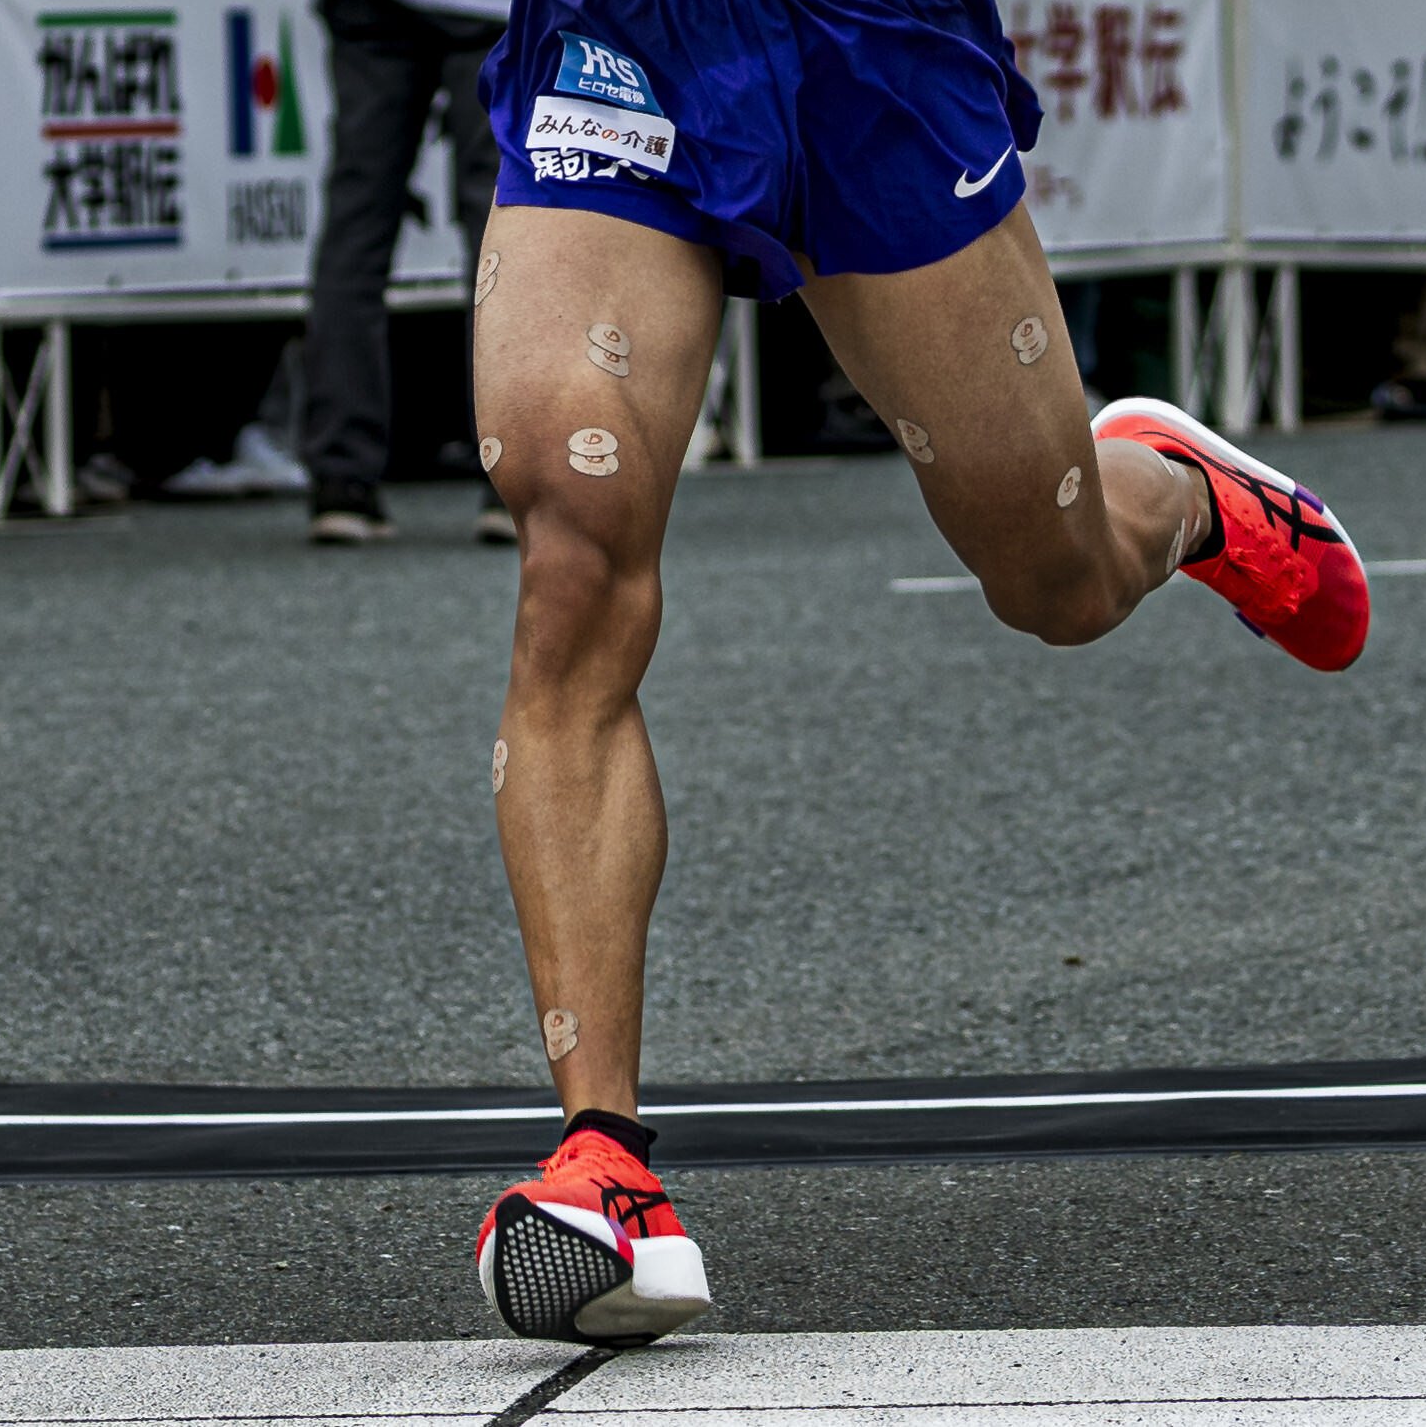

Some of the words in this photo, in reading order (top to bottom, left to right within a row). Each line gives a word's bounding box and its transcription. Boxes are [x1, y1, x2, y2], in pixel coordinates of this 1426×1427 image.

[580, 41, 640, 87] HRS
[535, 115, 670, 158] みんなの介護
